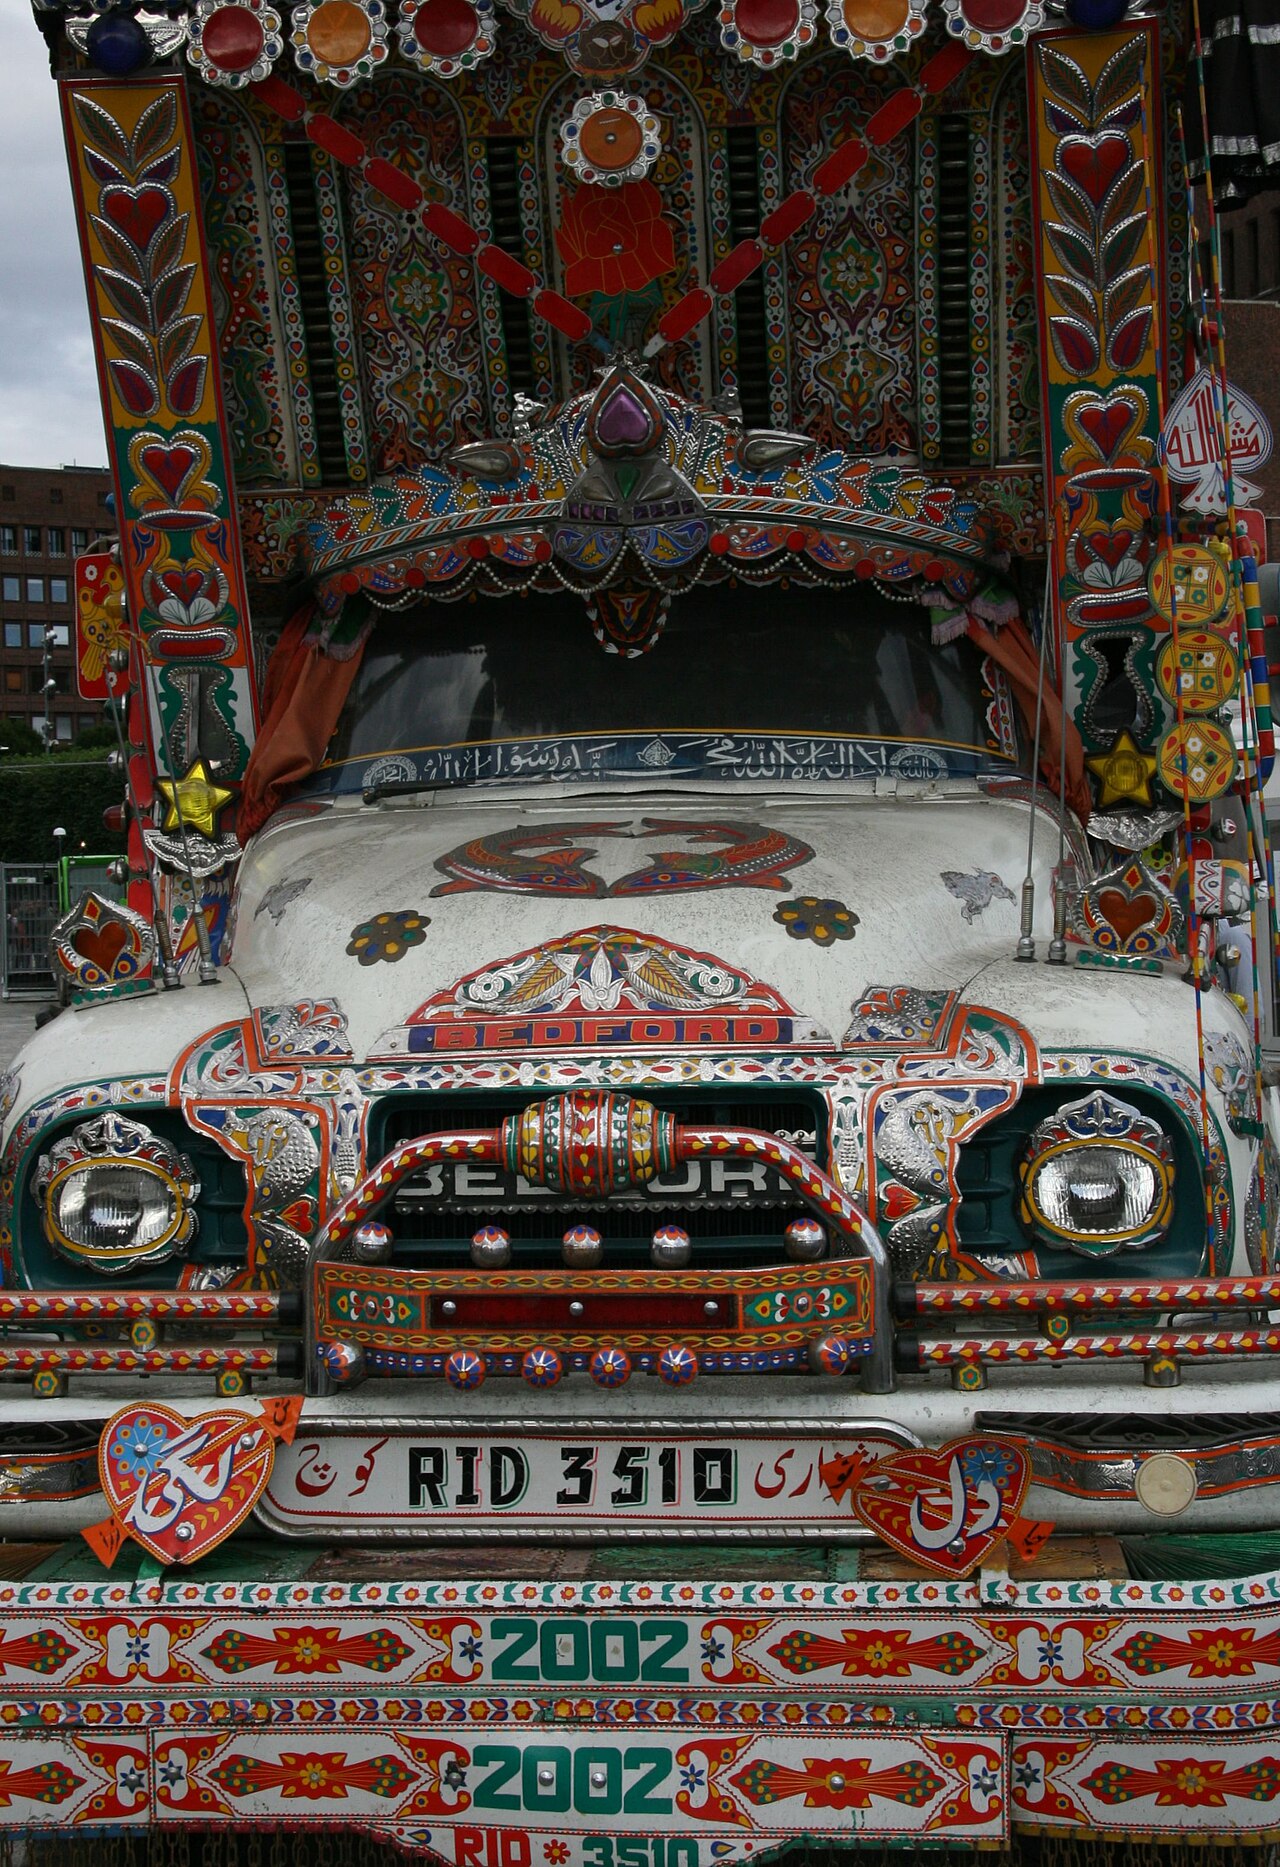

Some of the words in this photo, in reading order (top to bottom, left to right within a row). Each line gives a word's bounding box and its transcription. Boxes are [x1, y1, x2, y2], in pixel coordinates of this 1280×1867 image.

[433, 1017, 780, 1051] BEDFORD
[394, 1160, 794, 1197] BEOR
[408, 1446, 529, 1512] RID
[555, 1445, 739, 1509] 3510
[490, 1618, 690, 1683] 2002
[472, 1744, 673, 1815] 2002
[453, 1827, 532, 1867] RID
[582, 1836, 700, 1867] 3510
